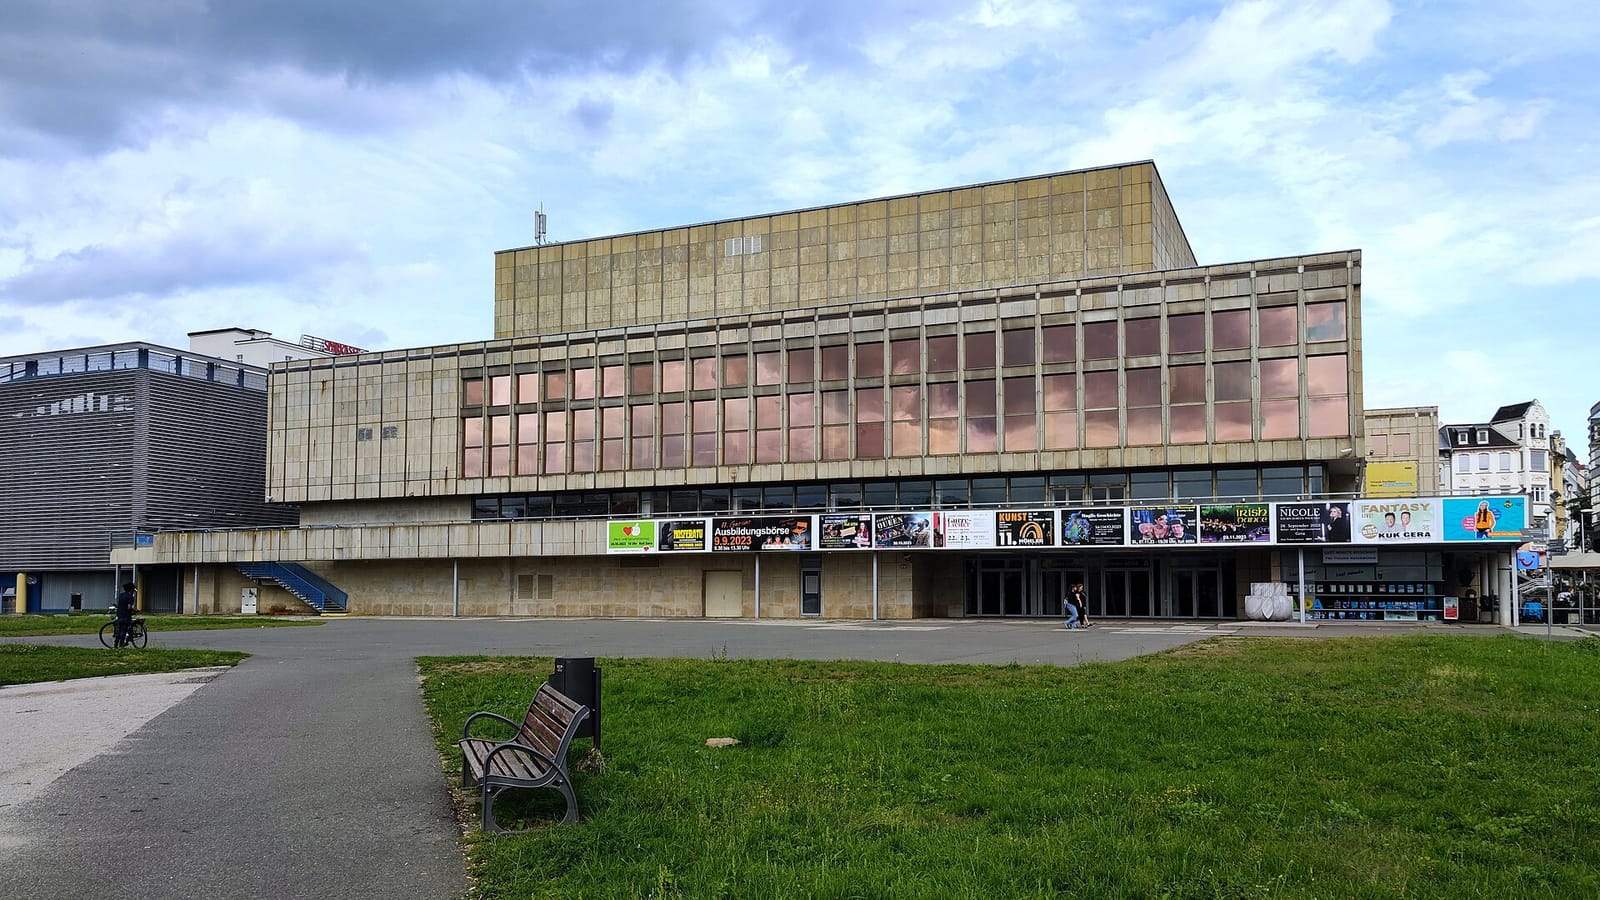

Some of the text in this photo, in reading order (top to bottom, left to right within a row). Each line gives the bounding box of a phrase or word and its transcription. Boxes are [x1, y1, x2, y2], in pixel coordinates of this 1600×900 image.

[1280, 508, 1320, 517] NICOLE
[1361, 503, 1431, 513] FANTASY
[999, 512, 1028, 522] KUNST
[877, 516, 903, 529] QUEEN
[673, 529, 704, 539] NOSFERATU
[714, 526, 790, 537] Ausbildungsbörse
[714, 536, 752, 546] 9.9.2023
[999, 532, 1018, 545] 11.
[1293, 598, 1324, 610] ADA
